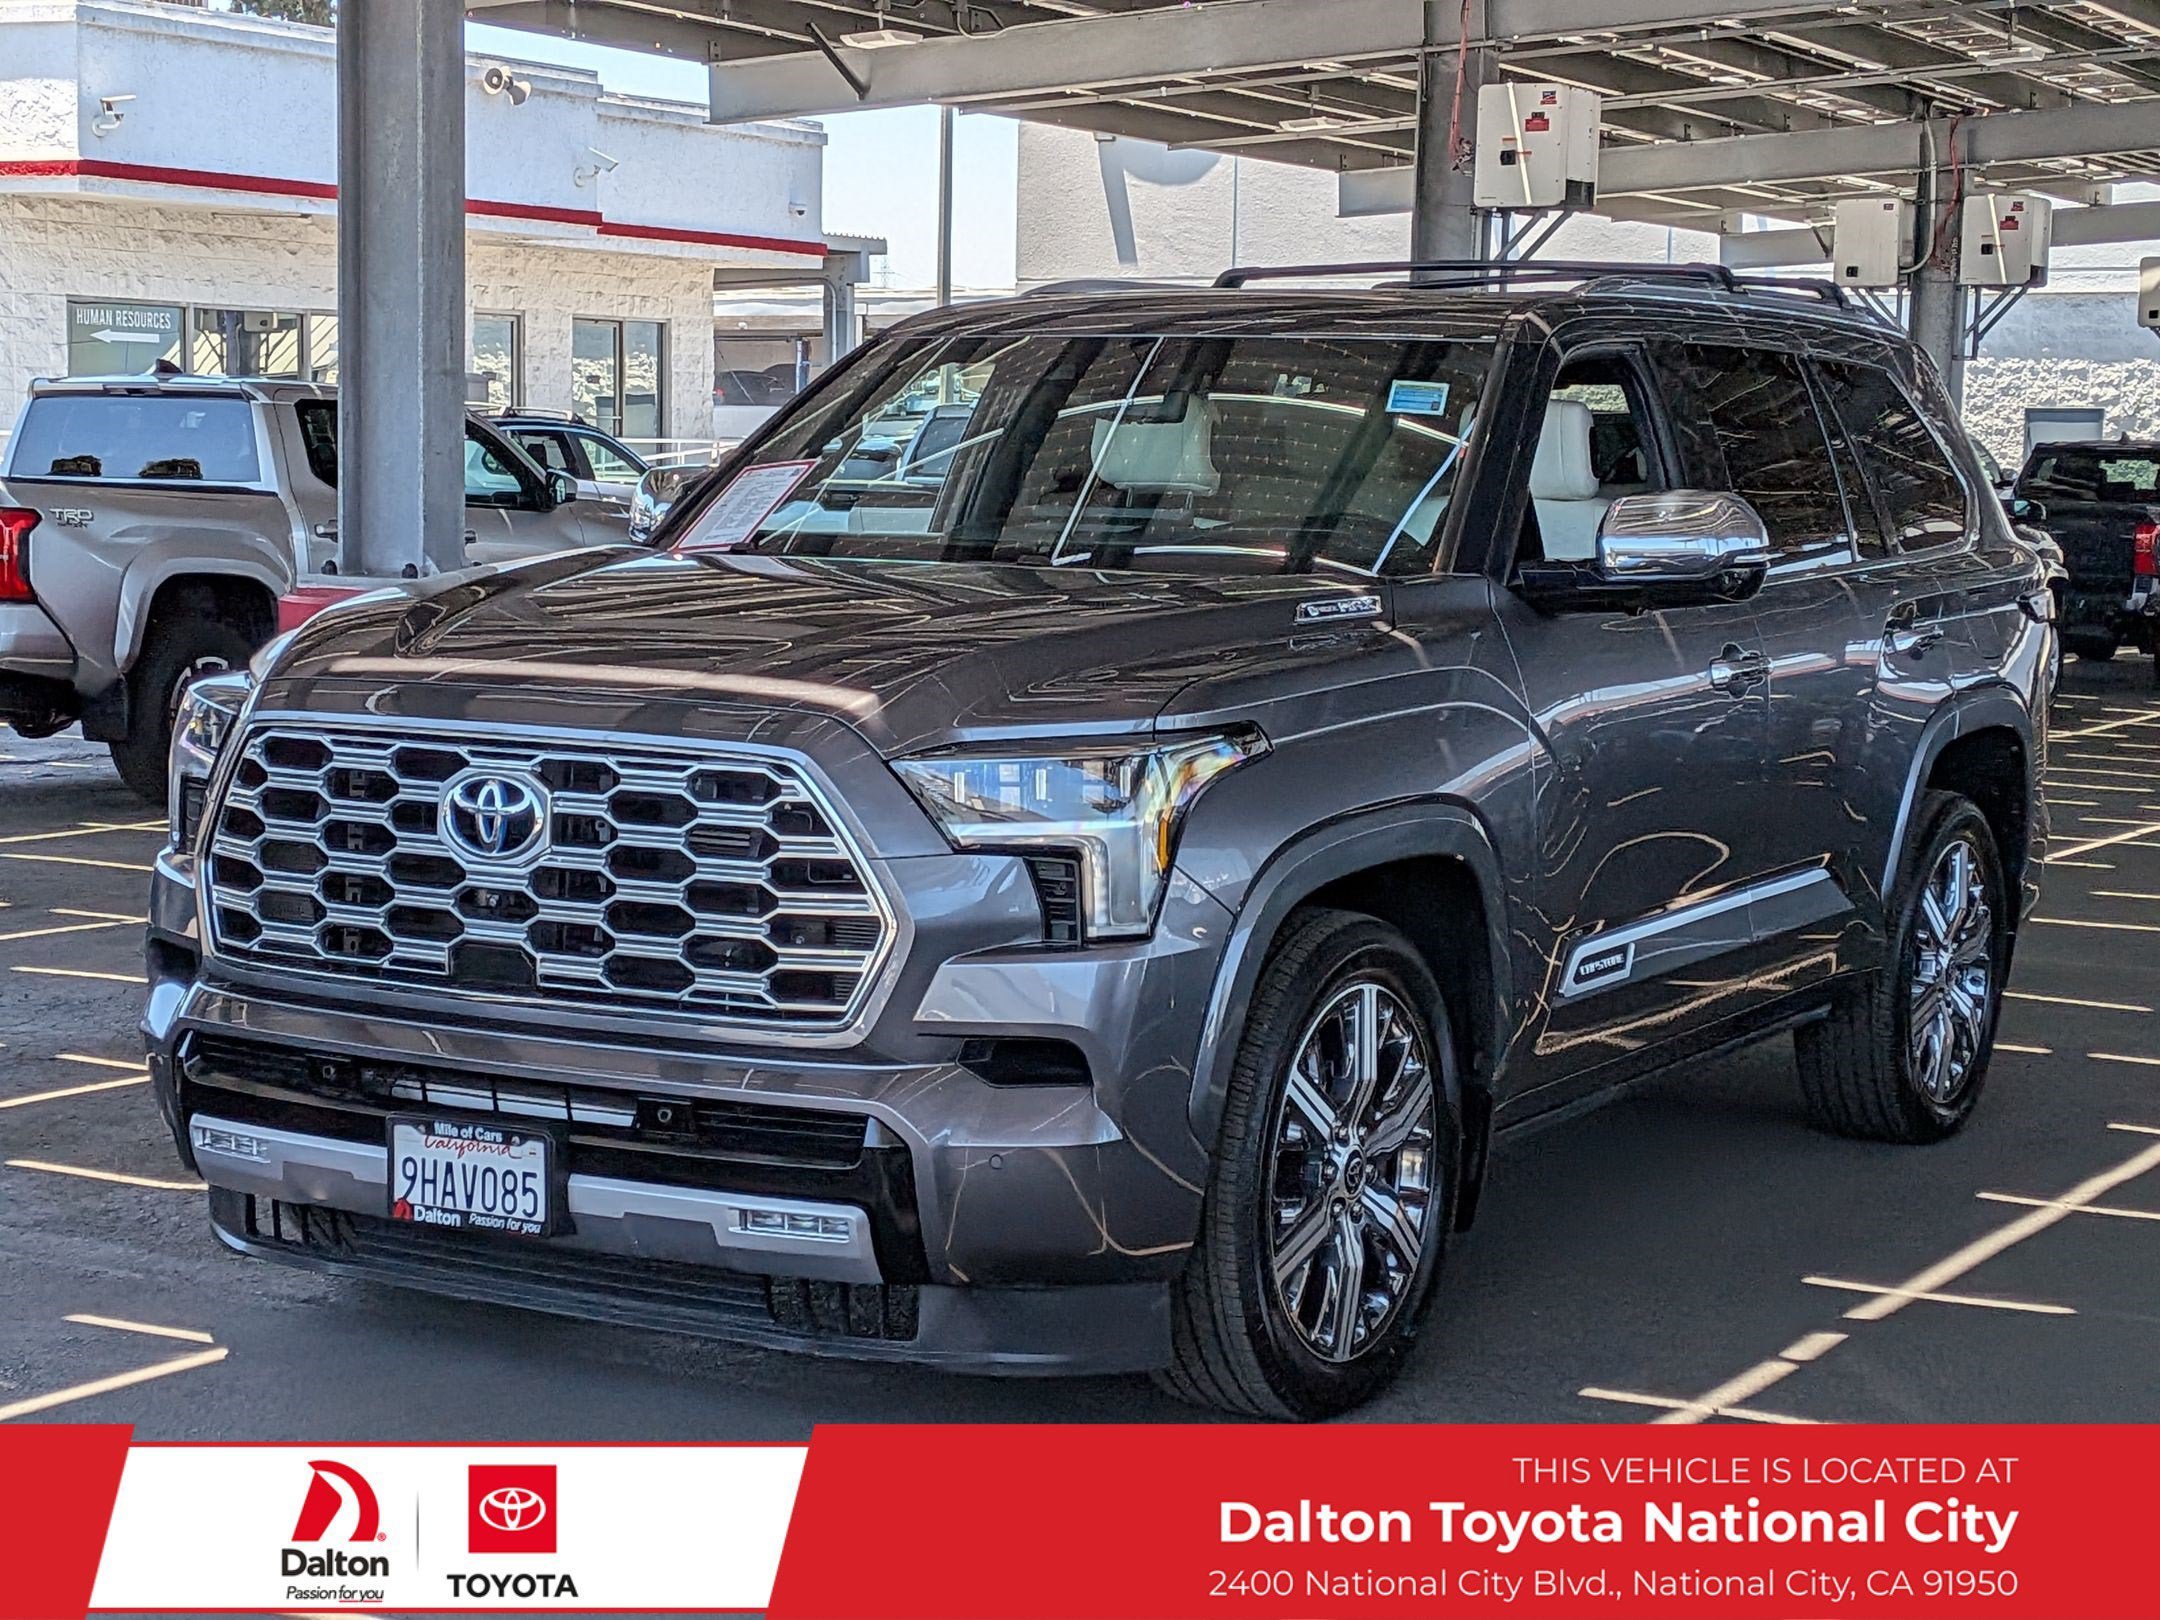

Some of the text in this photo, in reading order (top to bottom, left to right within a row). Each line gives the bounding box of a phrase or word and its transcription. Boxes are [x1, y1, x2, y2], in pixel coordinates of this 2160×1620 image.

[76, 308, 171, 329] HUMAN RESOURCES
[49, 508, 93, 522] TRD
[434, 1122, 503, 1142] Mile of Cars
[401, 1156, 538, 1219] 9HAV085
[413, 1205, 542, 1235] Dalton Passion for you
